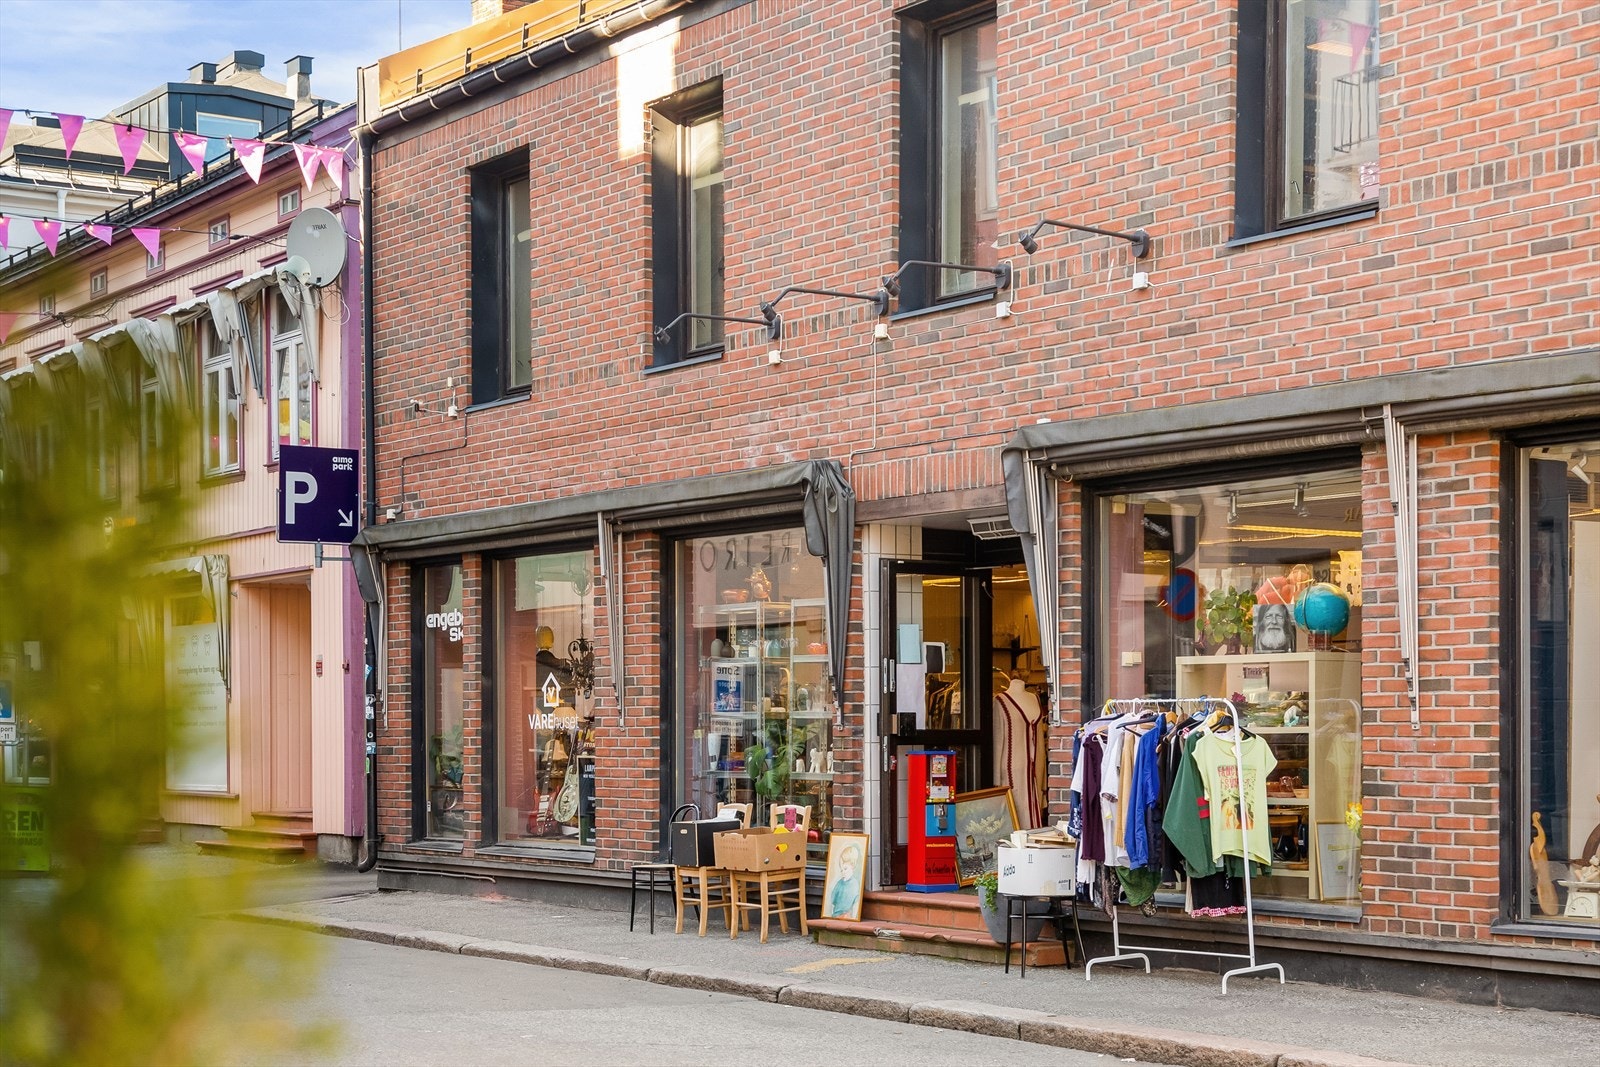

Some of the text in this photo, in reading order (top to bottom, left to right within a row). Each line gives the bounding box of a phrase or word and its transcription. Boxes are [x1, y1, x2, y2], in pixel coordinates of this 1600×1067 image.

[332, 456, 353, 464] aimo
[332, 463, 353, 471] park
[285, 471, 318, 524] P
[528, 713, 579, 730] VAREhuset
